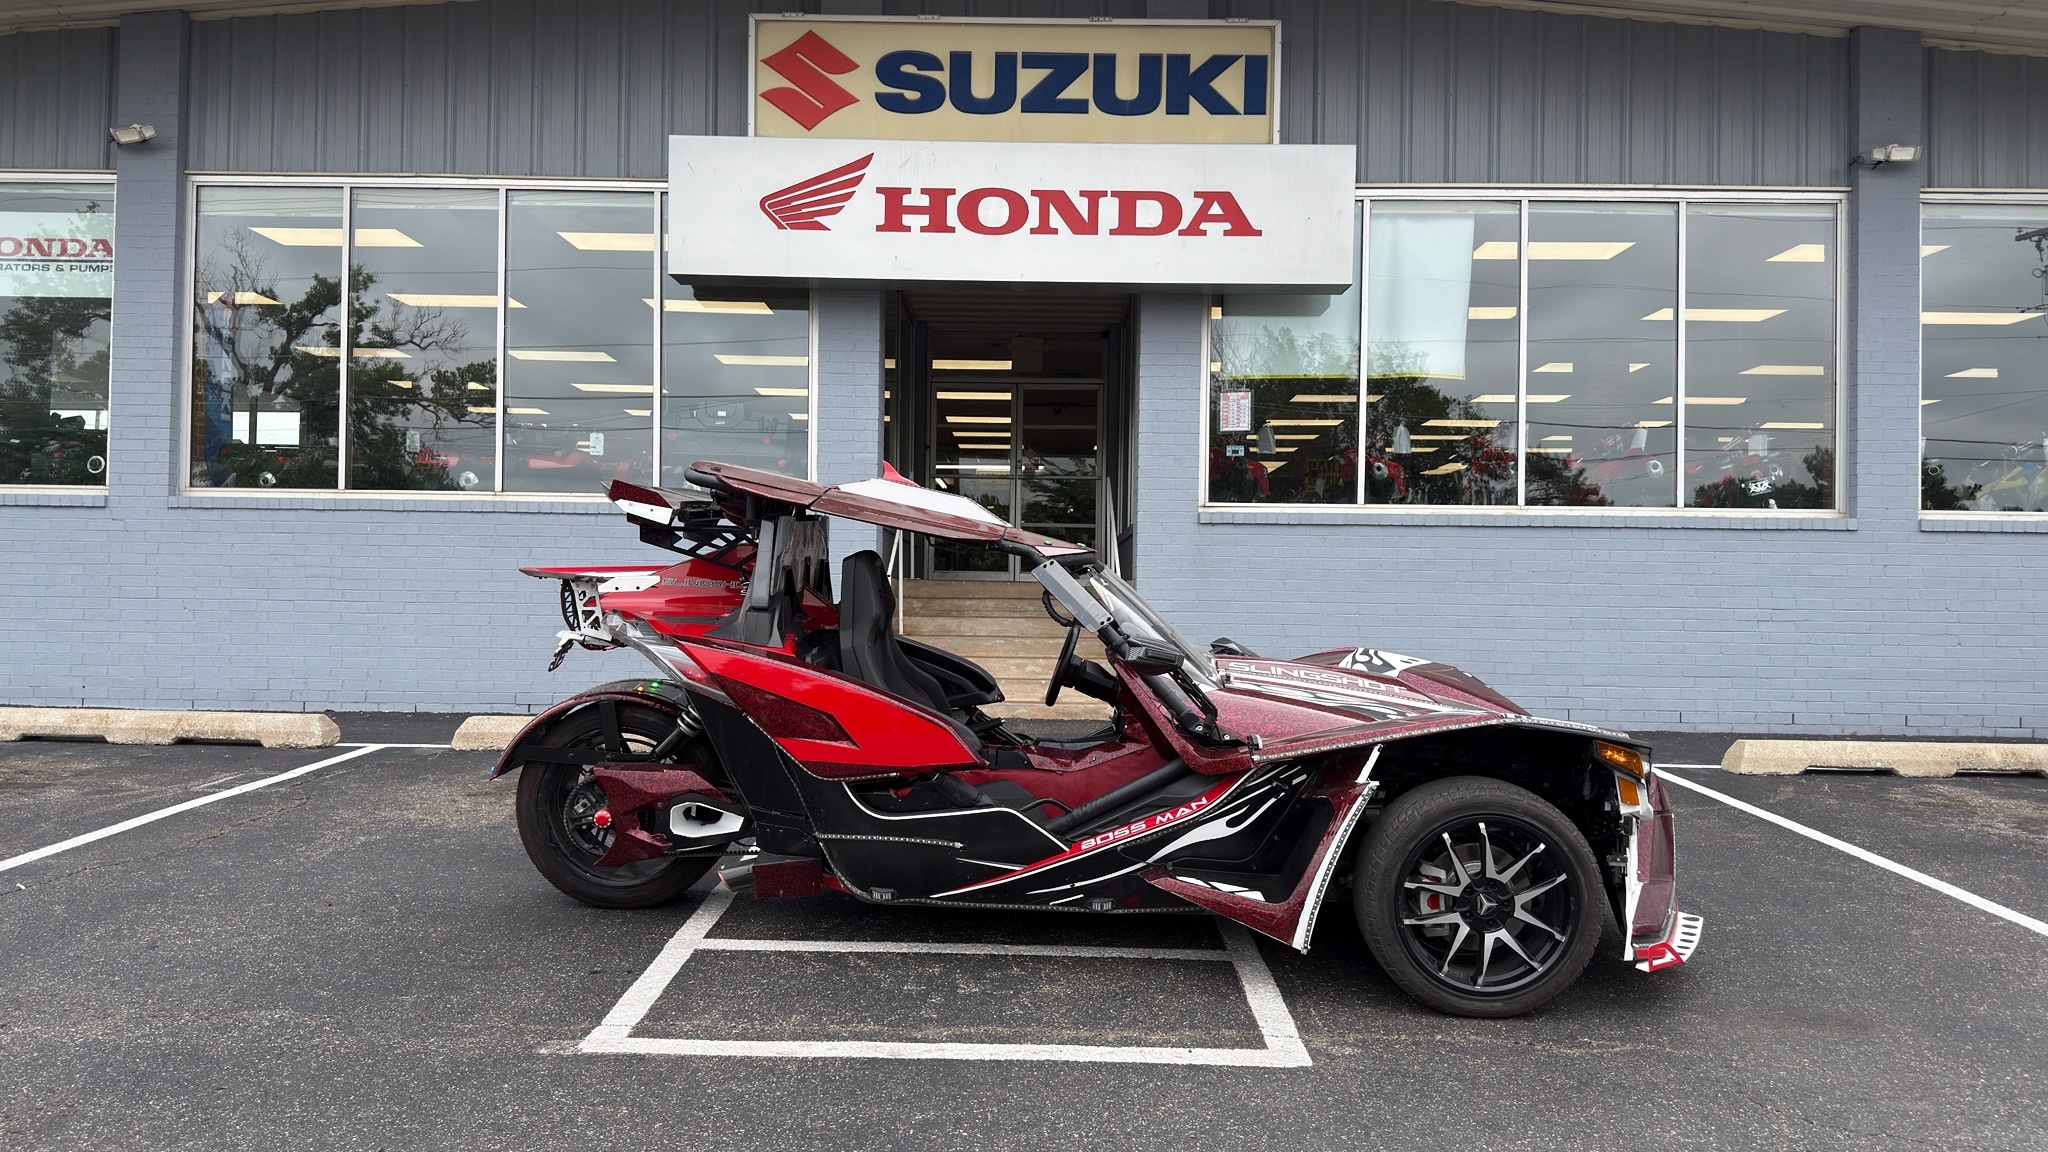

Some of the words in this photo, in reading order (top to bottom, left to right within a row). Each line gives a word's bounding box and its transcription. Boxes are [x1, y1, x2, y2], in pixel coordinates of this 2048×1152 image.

[874, 50, 1268, 116] SUZUKI
[875, 186, 1263, 237] HONDA
[55, 264, 65, 272] &
[1228, 661, 1408, 694] SLINGSHOT
[1081, 821, 1147, 850] BOSS
[1155, 797, 1208, 825] MAN
